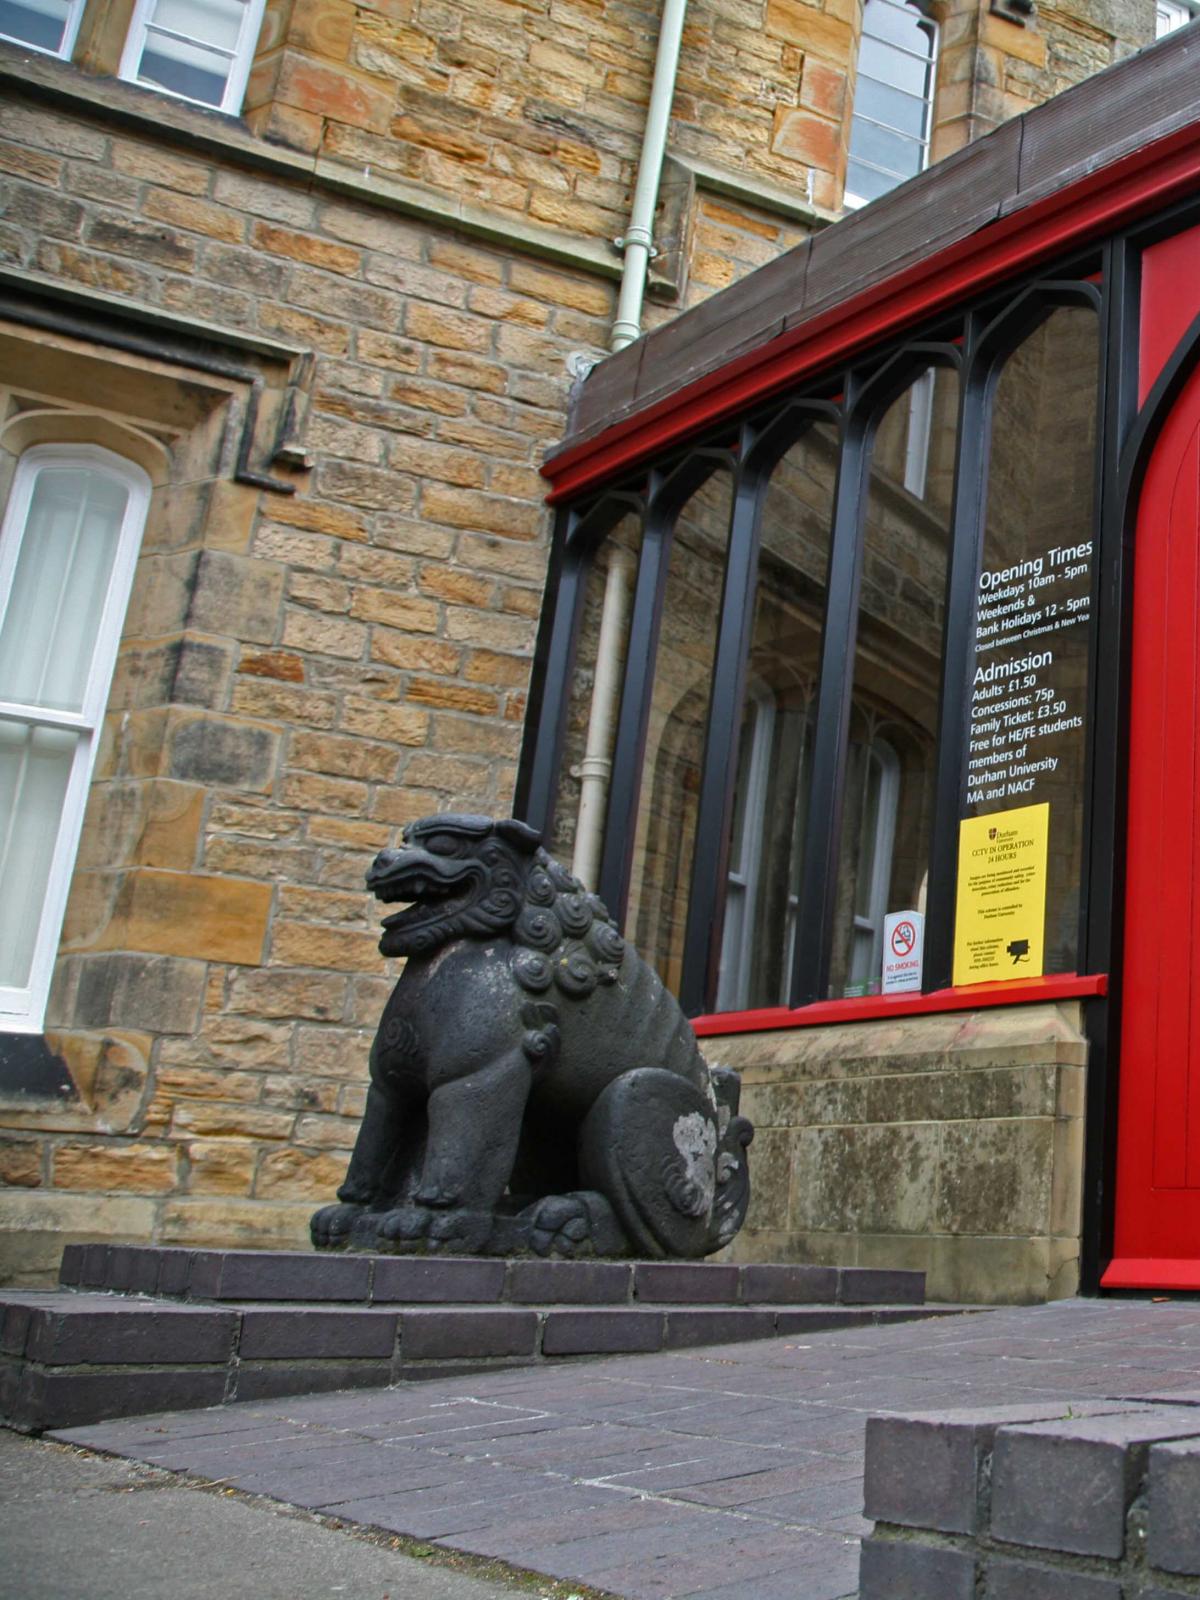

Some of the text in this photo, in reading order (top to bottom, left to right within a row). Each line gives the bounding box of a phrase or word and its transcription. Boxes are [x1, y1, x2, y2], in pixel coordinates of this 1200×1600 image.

[979, 541, 1093, 590] Opening Times
[977, 583, 1025, 605] Weekdays
[1028, 574, 1055, 590] 10am
[1064, 563, 1088, 579] 5pm
[976, 594, 1035, 621] Weekends &
[976, 622, 999, 638] Bank
[1001, 610, 1042, 630] Holidays
[1045, 604, 1057, 617] 12
[1066, 596, 1090, 612] 5pm
[974, 641, 995, 652] Closed
[995, 633, 1022, 646] between
[1022, 624, 1054, 639] Christmas
[1054, 621, 1060, 629] &
[1061, 618, 1076, 628] New
[973, 651, 1053, 685] Admission
[1008, 674, 1037, 693] £1.50
[971, 688, 1055, 718] Concessions: 75p
[969, 715, 1083, 752] Free for HE/FE students
[970, 701, 1067, 736] Family Ticket: £3.50
[968, 744, 1028, 769] members of
[968, 757, 1059, 787] Durham University
[966, 778, 1036, 804] MA and NACF
[971, 838, 1035, 857] CCTV IN OPERATION
[995, 852, 1017, 862] HOURS
[886, 960, 919, 972] NO SMOKING
